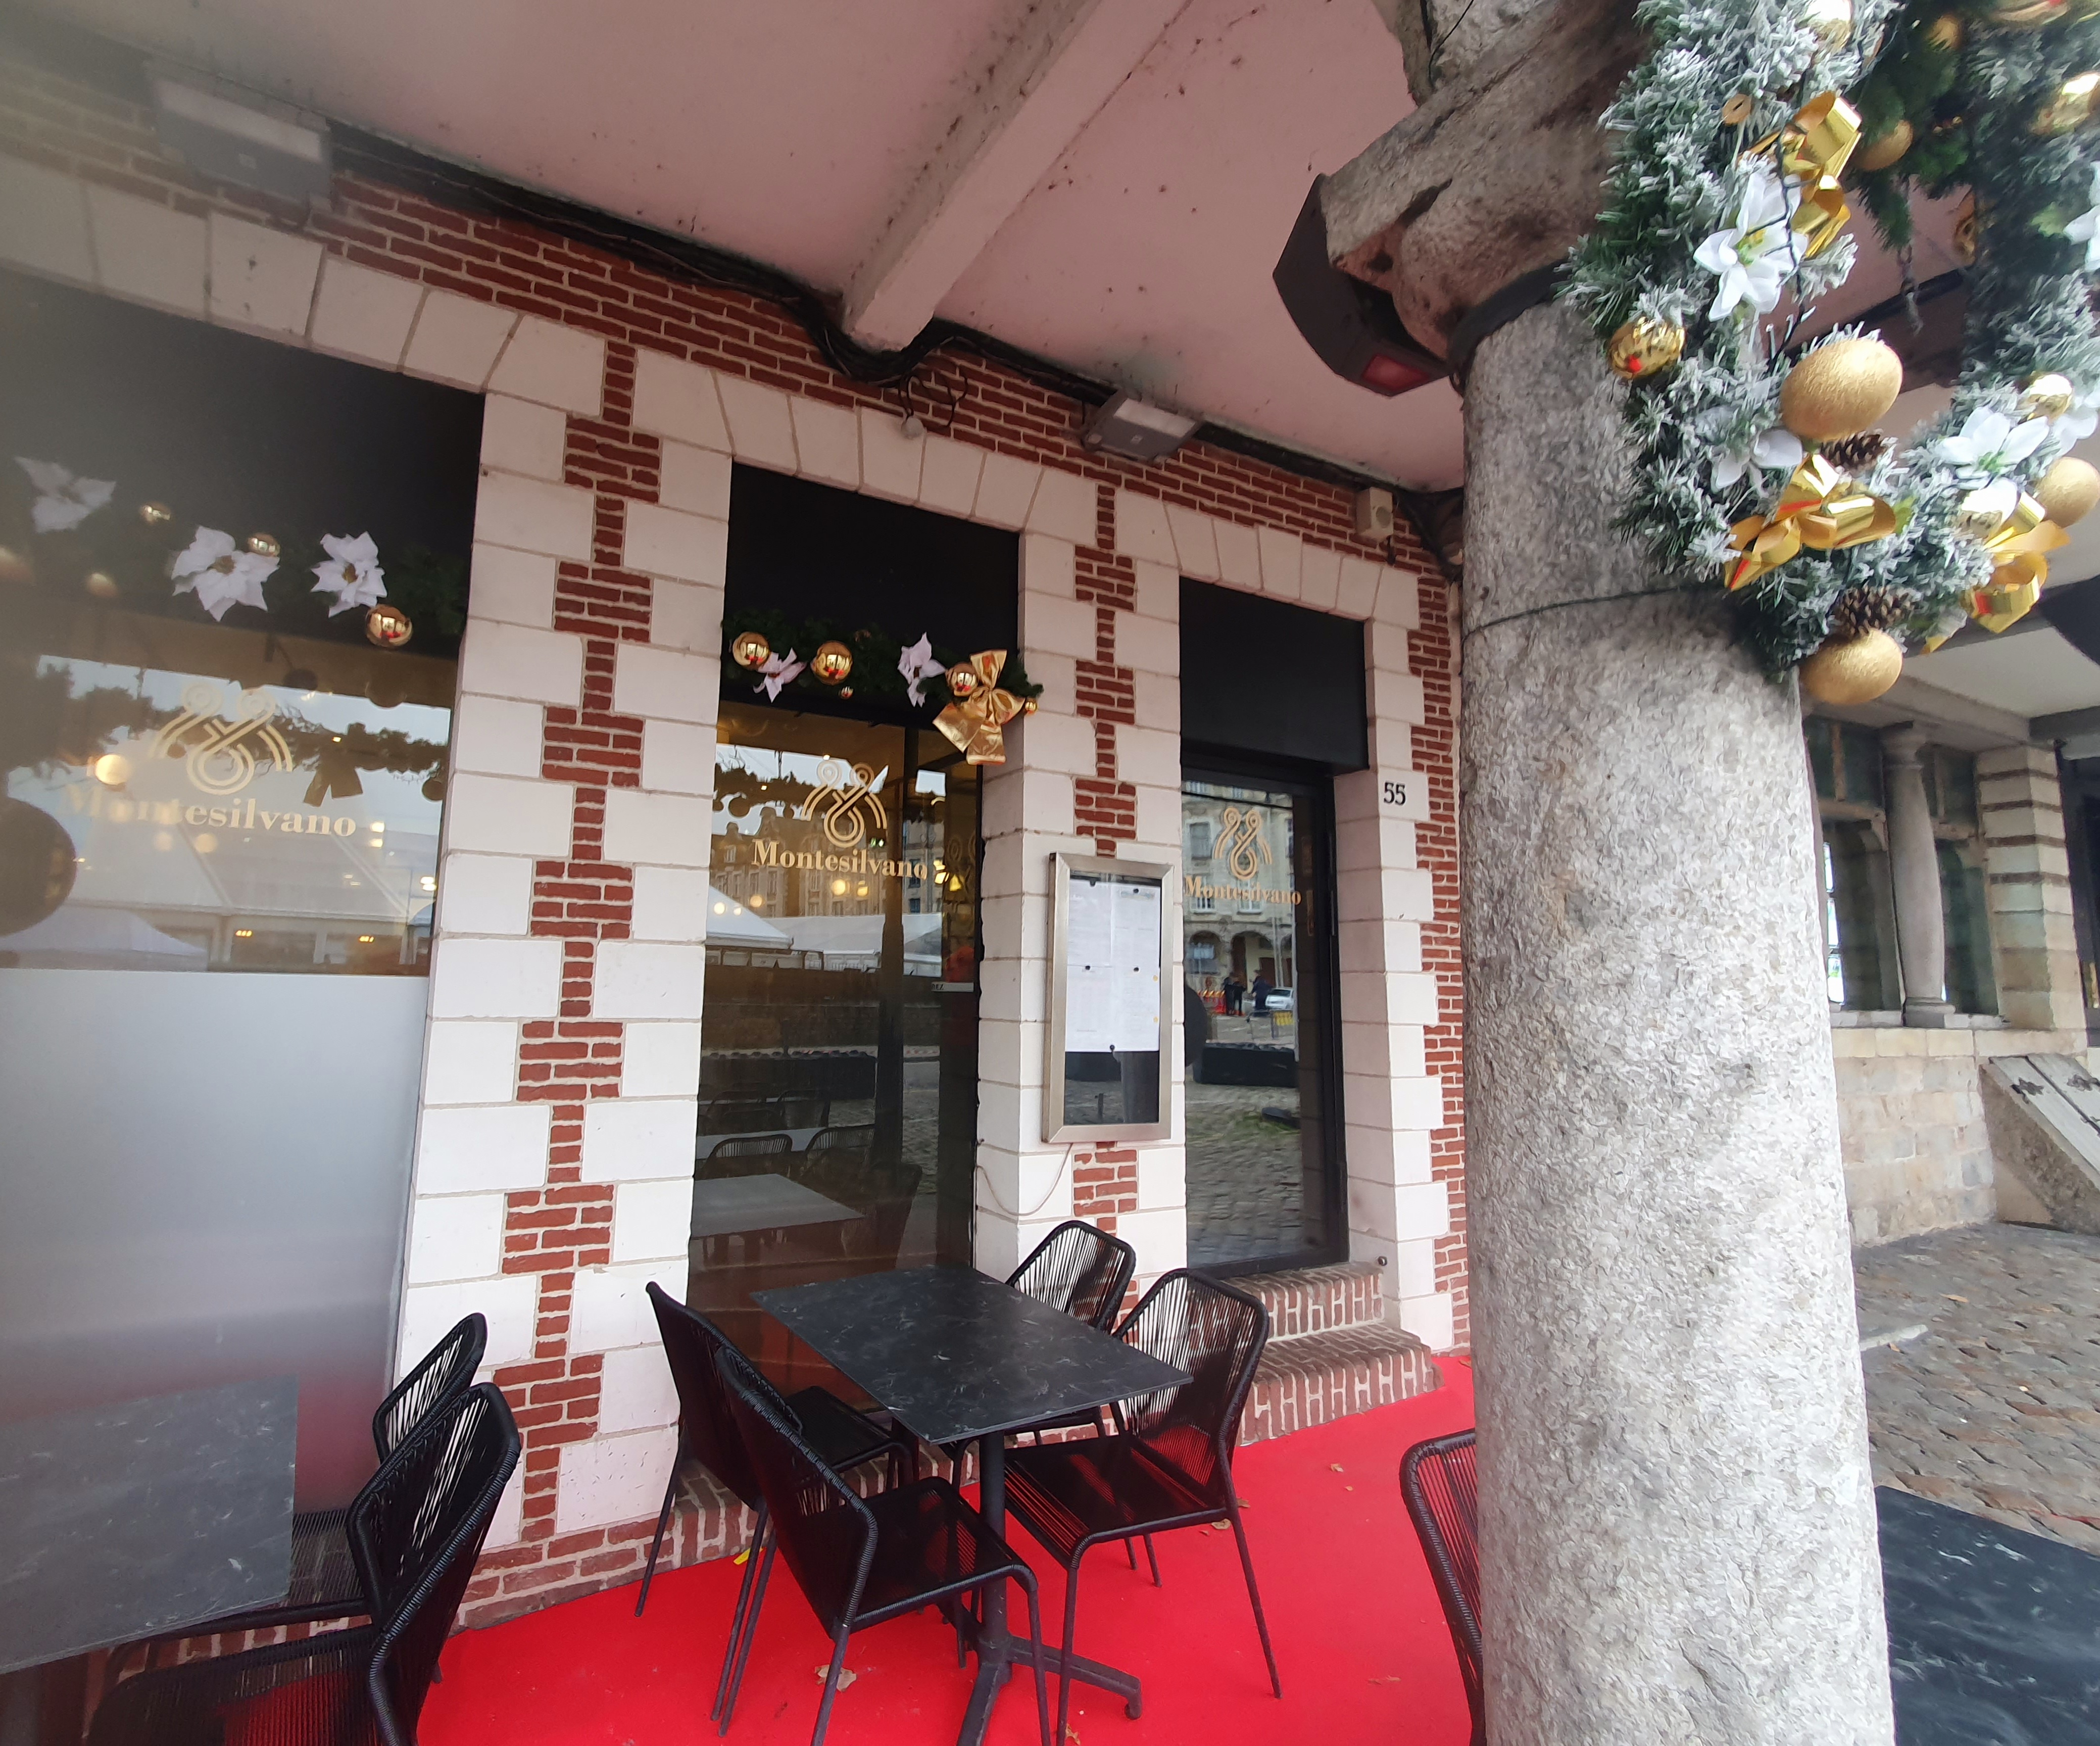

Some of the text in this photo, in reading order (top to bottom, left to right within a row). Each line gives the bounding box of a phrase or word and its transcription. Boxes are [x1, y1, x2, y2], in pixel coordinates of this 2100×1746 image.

[1383, 781, 1406, 806] 55
[751, 839, 928, 880] Montesilvano
[1185, 875, 1302, 905] Montesilvano
